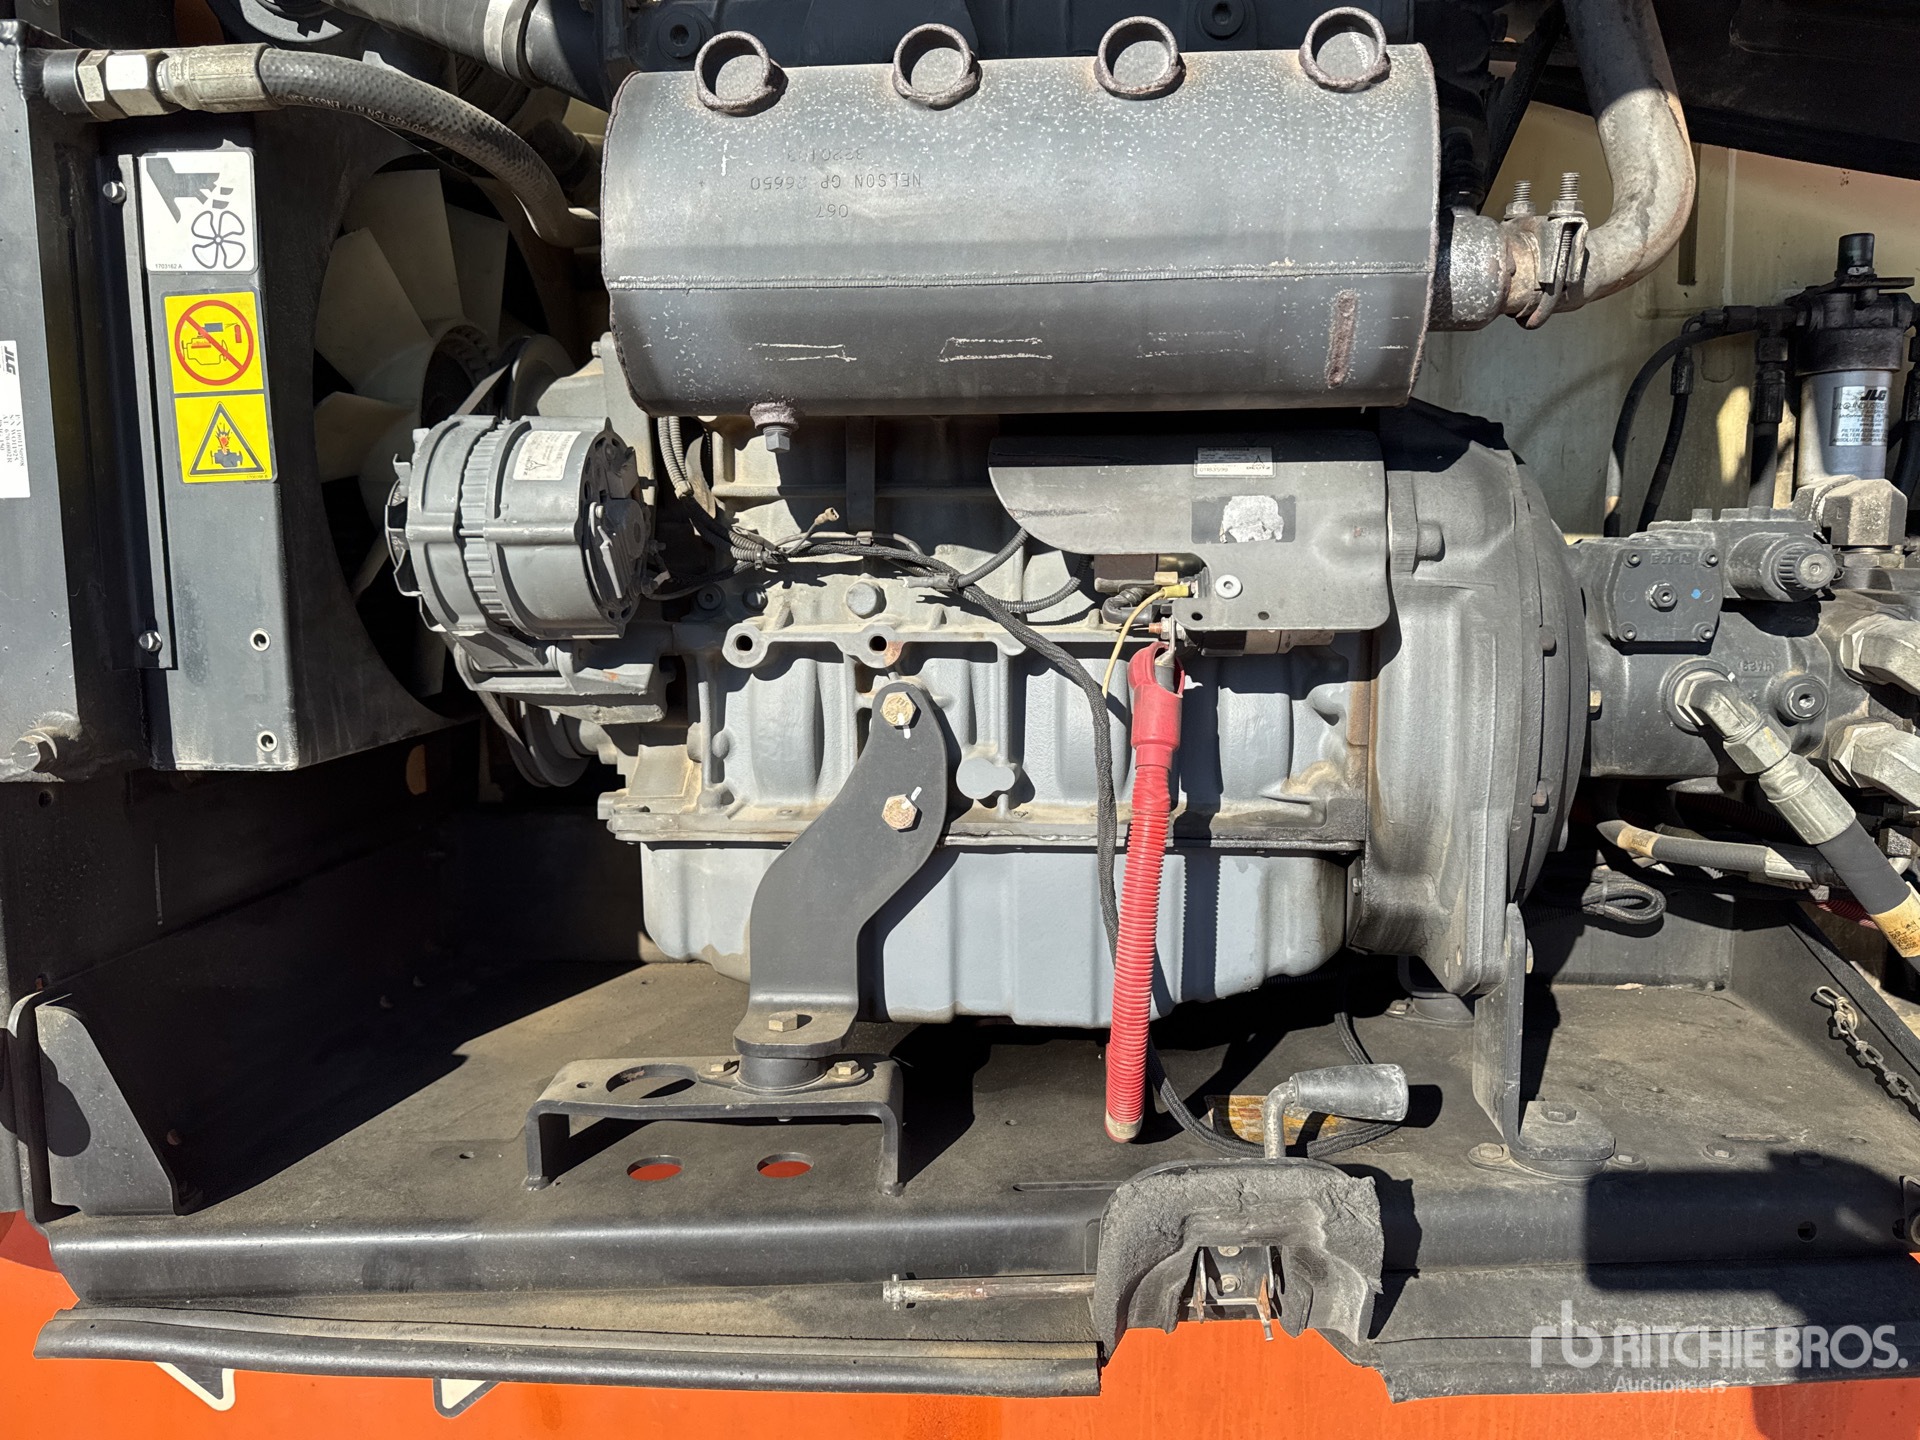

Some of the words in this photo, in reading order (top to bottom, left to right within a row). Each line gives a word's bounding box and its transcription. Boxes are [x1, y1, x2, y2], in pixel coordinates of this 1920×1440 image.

[750, 176, 807, 190] 26650
[819, 174, 842, 189] GP
[854, 172, 922, 188] NELSON
[815, 203, 849, 218] 067
[5, 346, 16, 375] JLG
[1860, 390, 1887, 401] JLG
